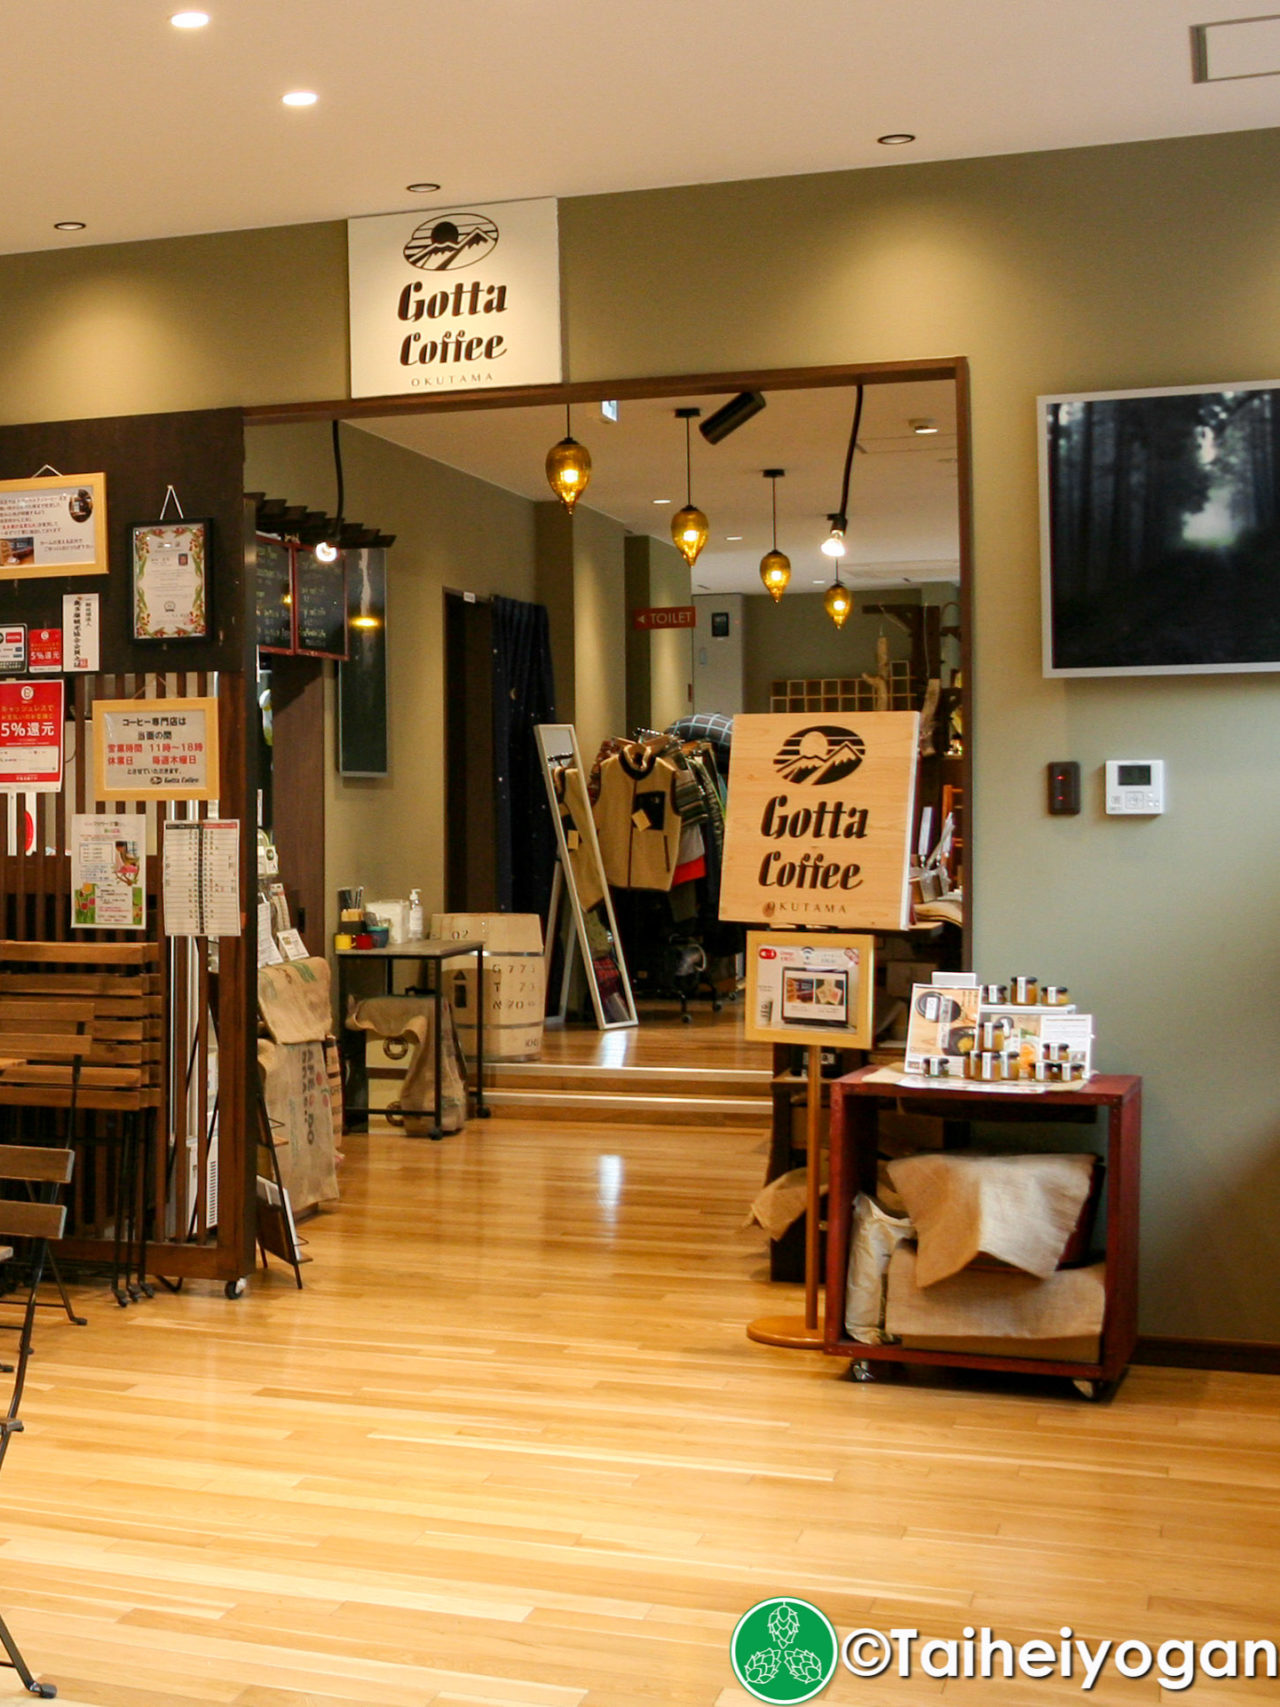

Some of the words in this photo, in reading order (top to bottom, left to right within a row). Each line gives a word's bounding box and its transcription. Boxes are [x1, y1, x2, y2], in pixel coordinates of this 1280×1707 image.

[397, 281, 508, 322] Gotta
[399, 330, 508, 366] Coffee
[411, 373, 493, 387] OKUTAMA
[650, 611, 692, 625] TOILET
[122, 717, 186, 726] コーヒー専門店は
[0, 722, 55, 737] 5%還元
[138, 731, 172, 740] 当面の間
[108, 744, 143, 753] 営業時間
[108, 756, 133, 765] 休業日
[761, 795, 869, 839] Gotta
[758, 851, 863, 890] Coffee
[767, 901, 847, 913] OKUTAMA
